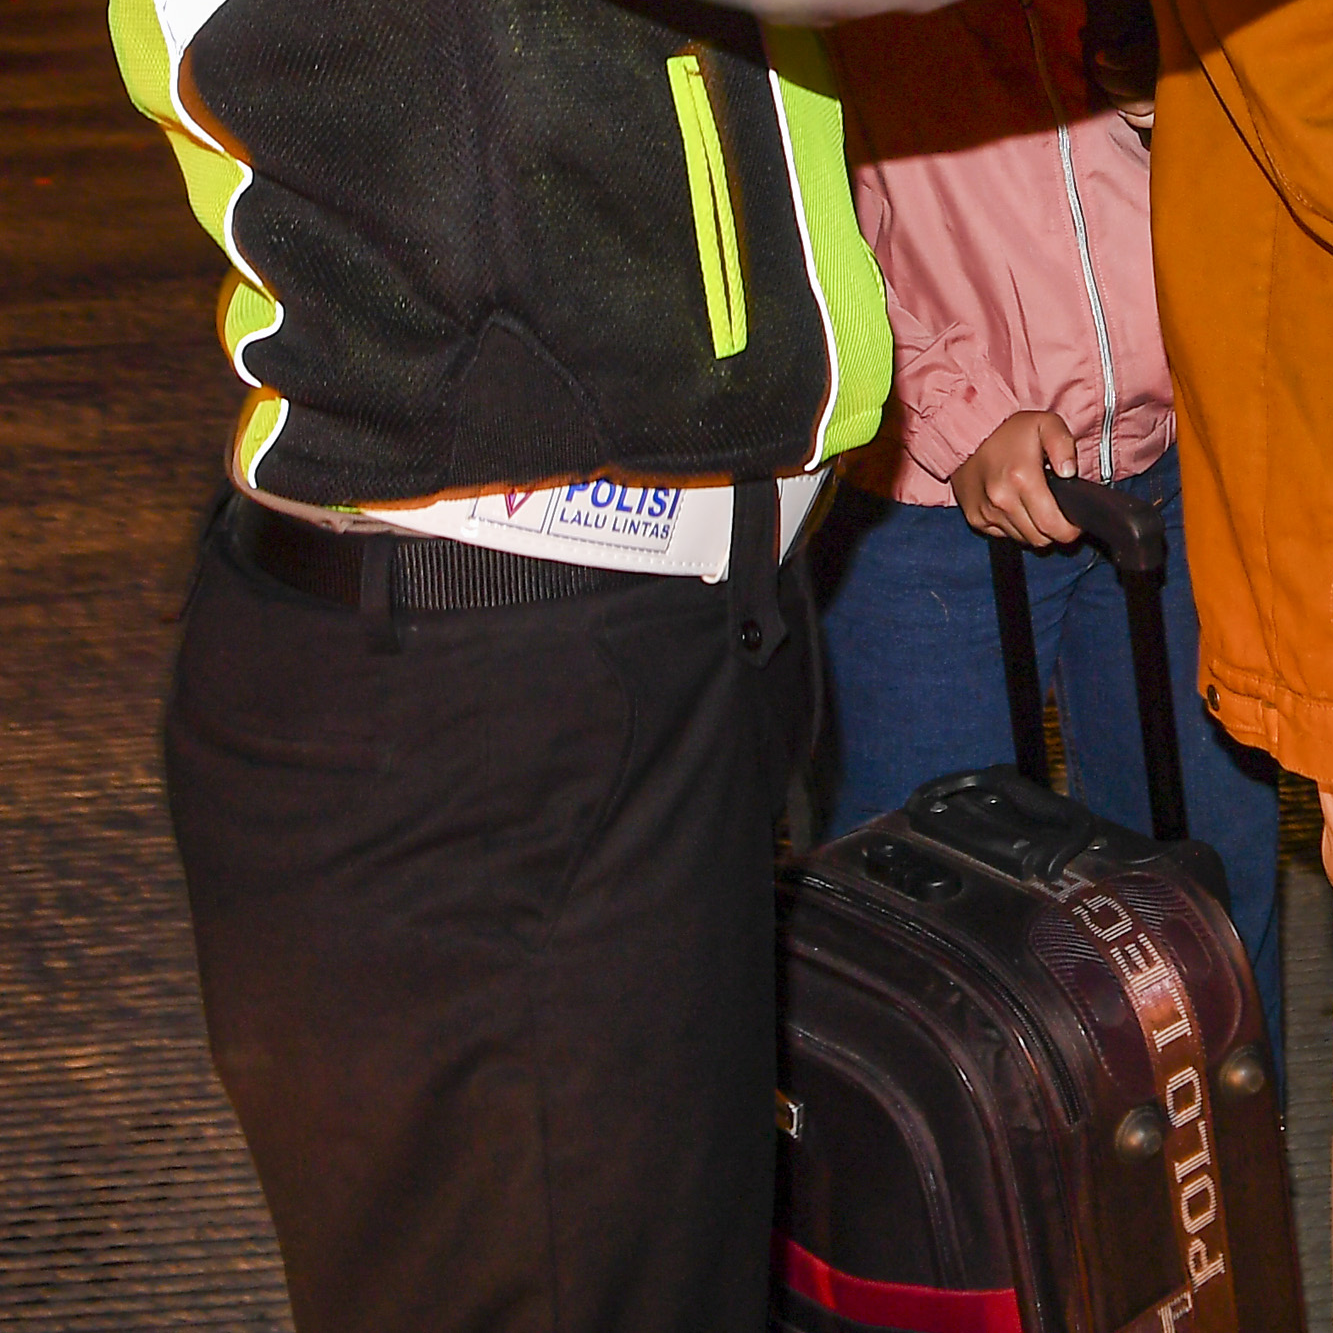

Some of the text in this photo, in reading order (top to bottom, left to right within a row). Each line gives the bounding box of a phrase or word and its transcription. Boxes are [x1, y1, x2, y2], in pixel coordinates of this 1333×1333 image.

[565, 478, 682, 520] POLISI
[560, 508, 671, 540] LALU LINTAS
[1165, 1066, 1226, 1293] POLO
